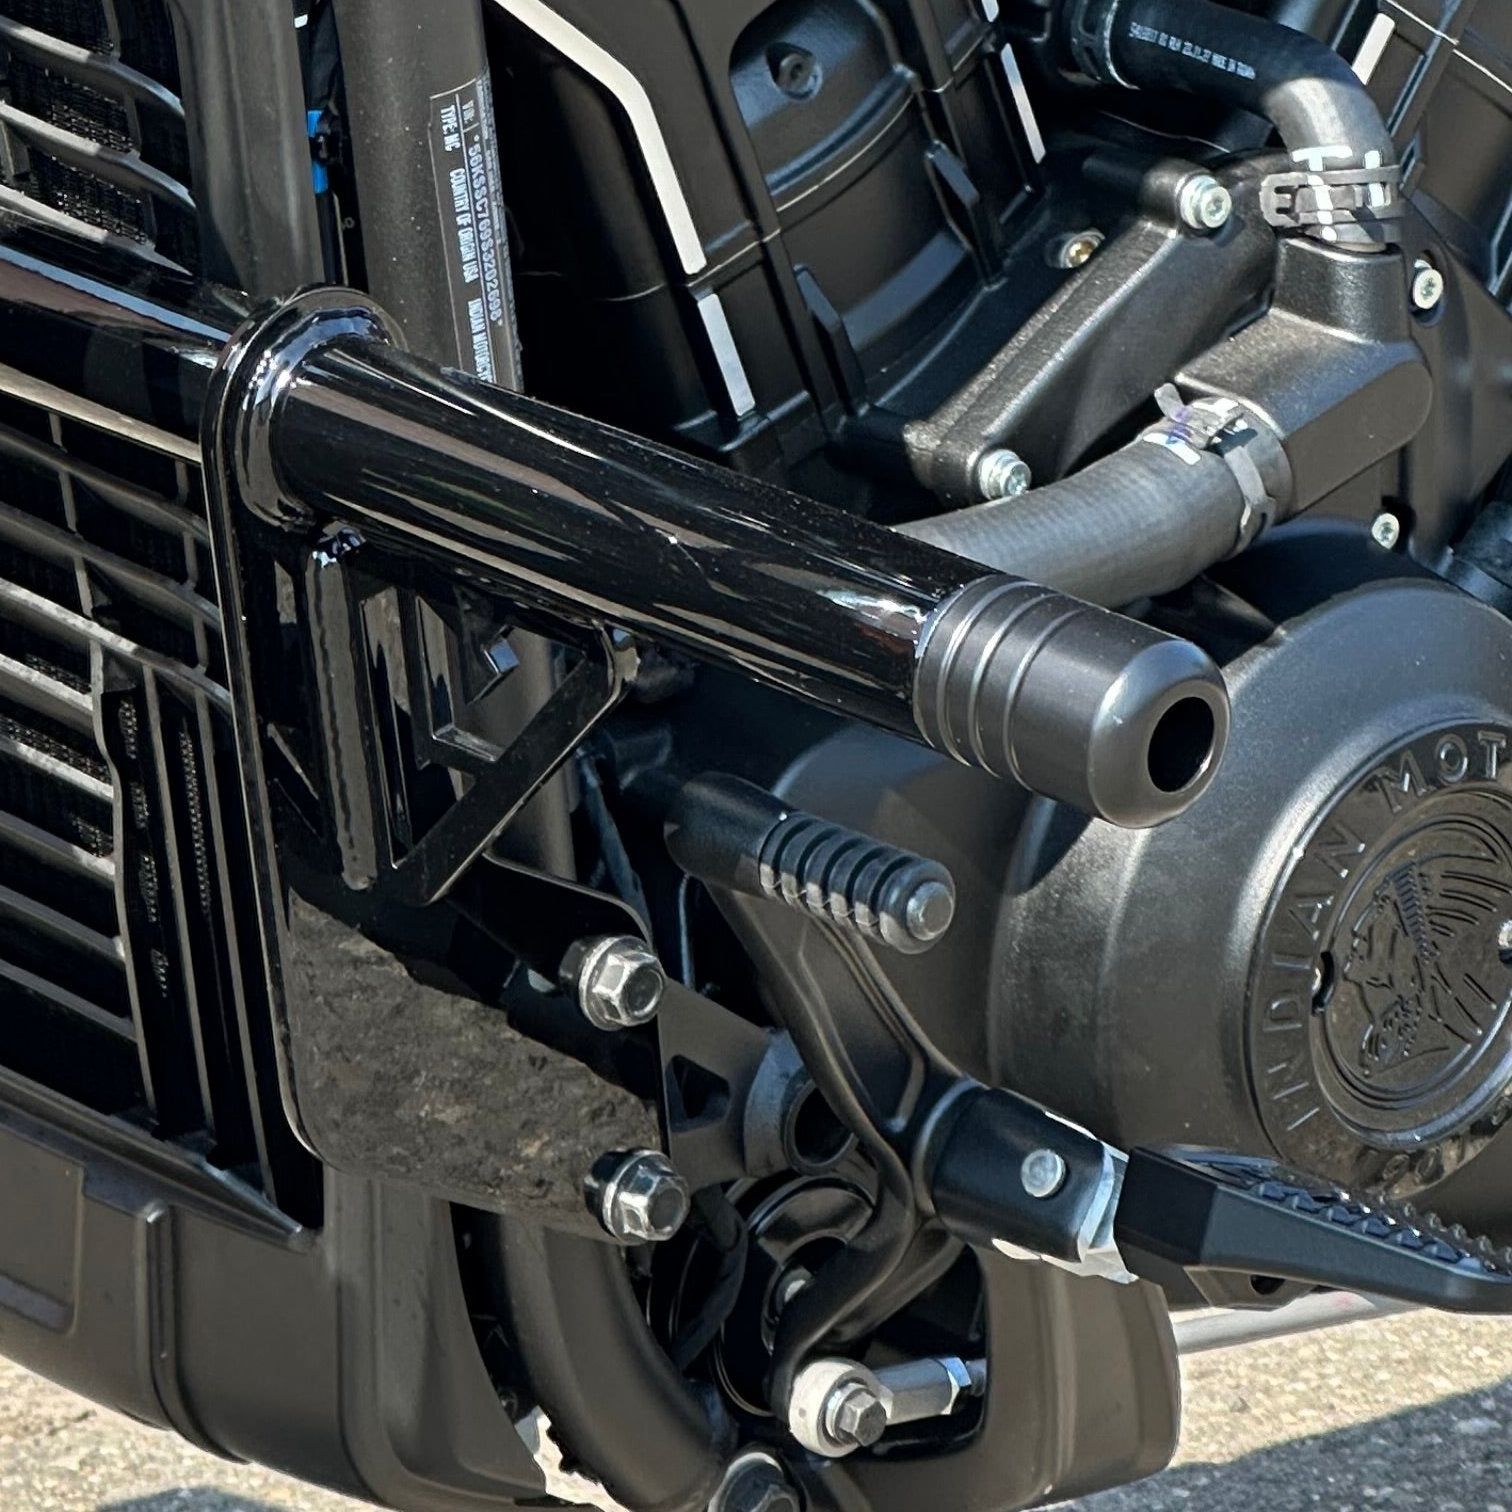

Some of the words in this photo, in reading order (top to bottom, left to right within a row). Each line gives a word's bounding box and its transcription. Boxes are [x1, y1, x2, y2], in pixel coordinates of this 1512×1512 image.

[448, 168, 469, 212] COUNTRY
[462, 261, 479, 282] USA
[1262, 822, 1366, 1132] INDIAN
